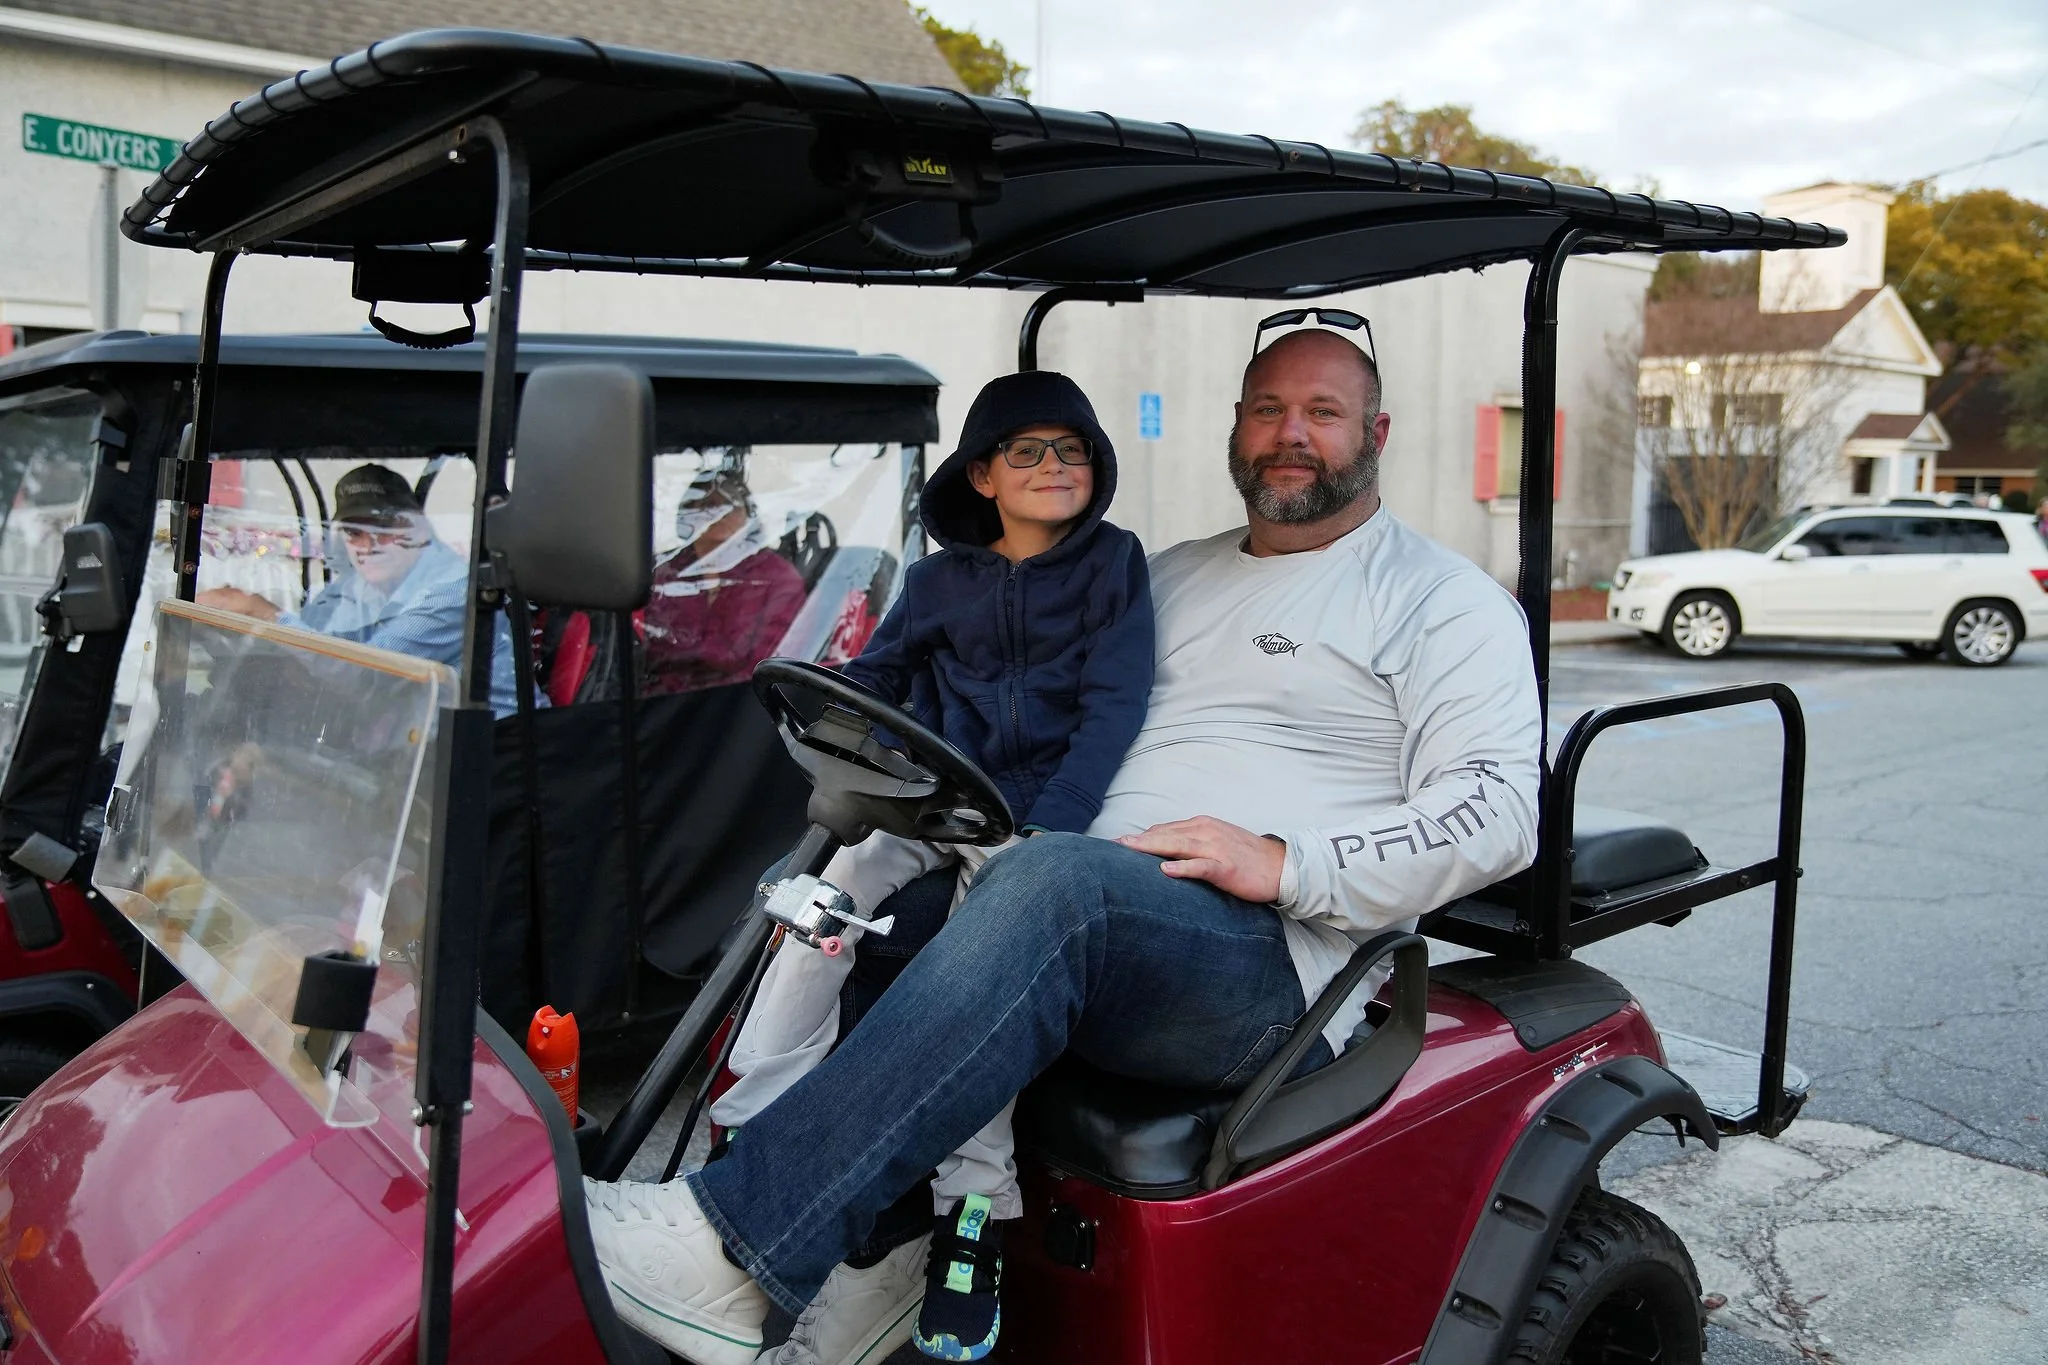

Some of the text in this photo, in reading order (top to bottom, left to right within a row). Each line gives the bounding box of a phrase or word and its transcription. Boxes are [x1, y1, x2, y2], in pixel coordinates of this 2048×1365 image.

[23, 117, 48, 150] E.
[56, 124, 161, 169] CONYERS
[1330, 759, 1504, 870] PALMYH
